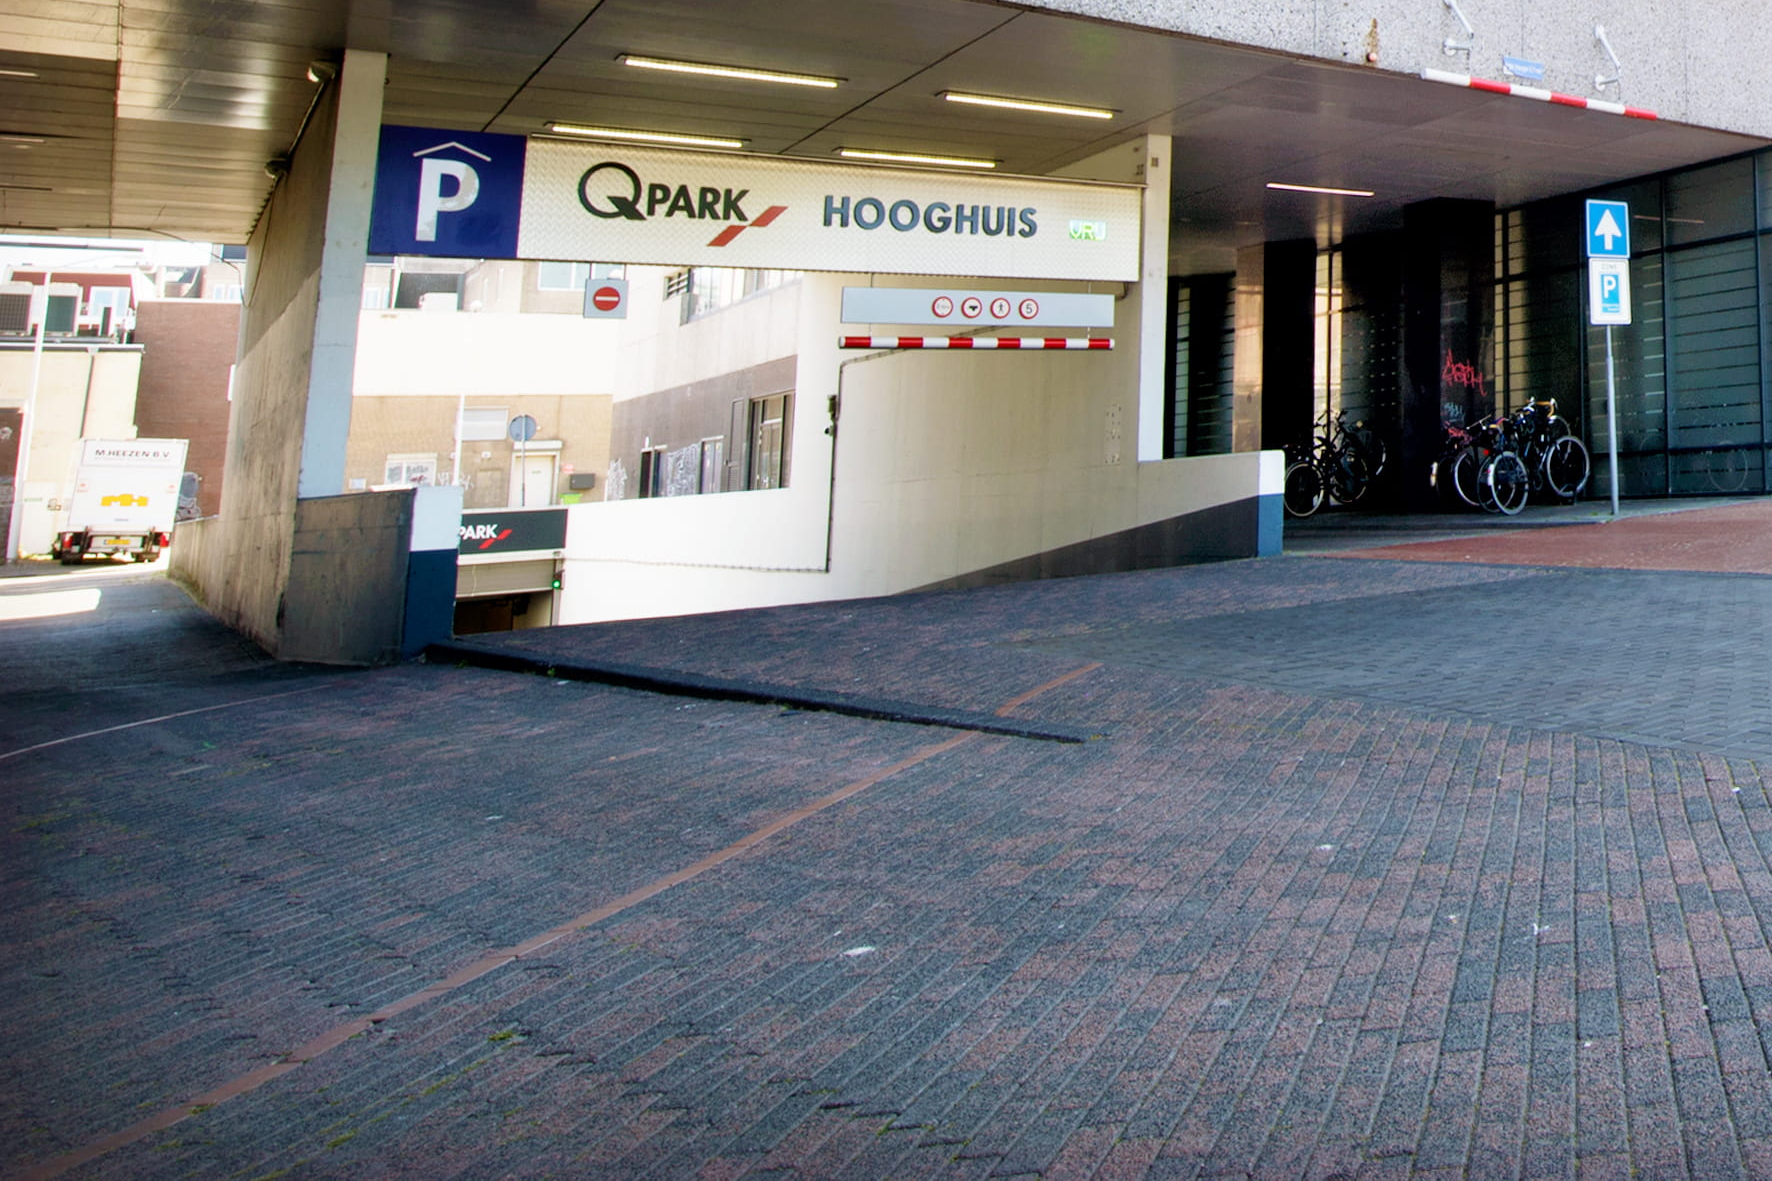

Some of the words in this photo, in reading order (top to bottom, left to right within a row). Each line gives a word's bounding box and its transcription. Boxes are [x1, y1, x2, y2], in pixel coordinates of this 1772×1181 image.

[415, 157, 480, 242] P
[823, 195, 1037, 238] HOOGHUIS
[1603, 275, 1617, 299] P
[1025, 302, 1033, 314] 5
